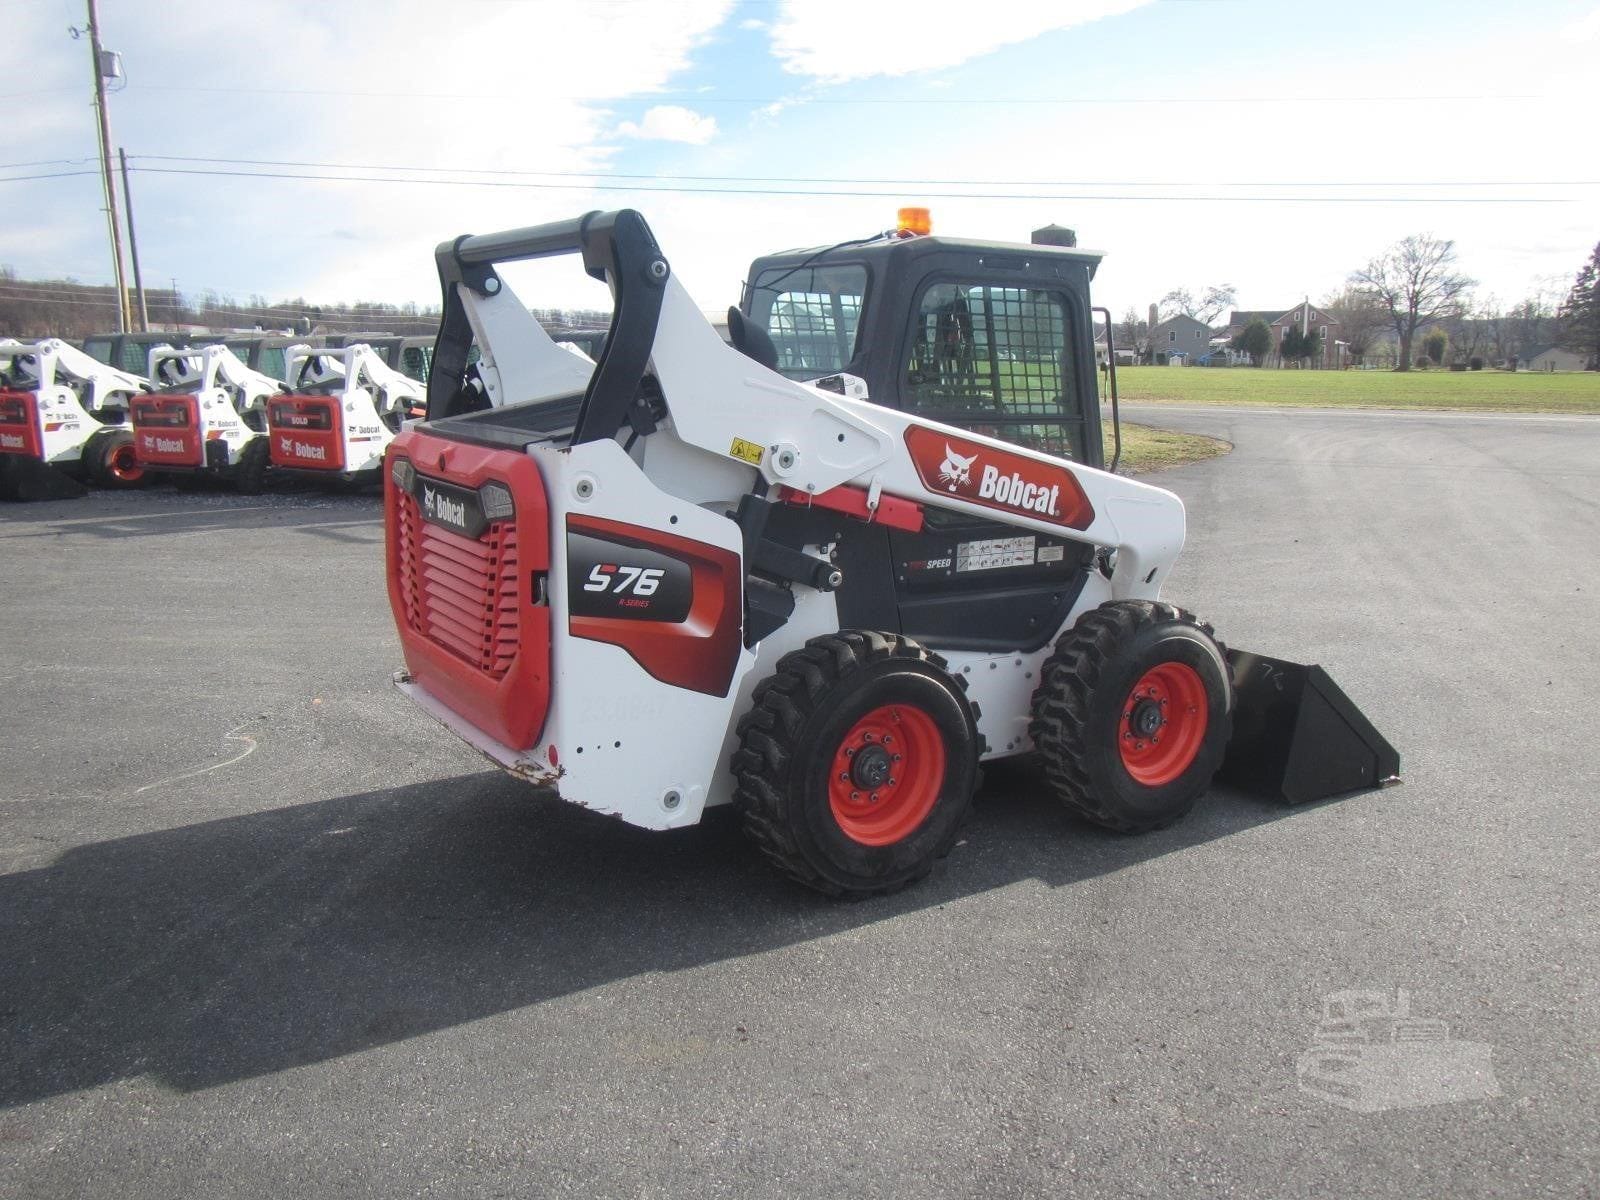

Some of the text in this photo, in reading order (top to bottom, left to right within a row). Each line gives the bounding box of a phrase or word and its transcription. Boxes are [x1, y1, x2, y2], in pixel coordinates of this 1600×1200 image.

[291, 416, 308, 425] SOLD
[359, 425, 380, 434] Bobcat
[157, 437, 185, 453] Bobcat
[295, 441, 326, 460] Bobcat
[979, 465, 1058, 516] Bobcat
[436, 494, 465, 527] Bobcat
[926, 557, 952, 570] SPEED
[584, 564, 665, 595] S76
[618, 598, 649, 608] R-SERIES
